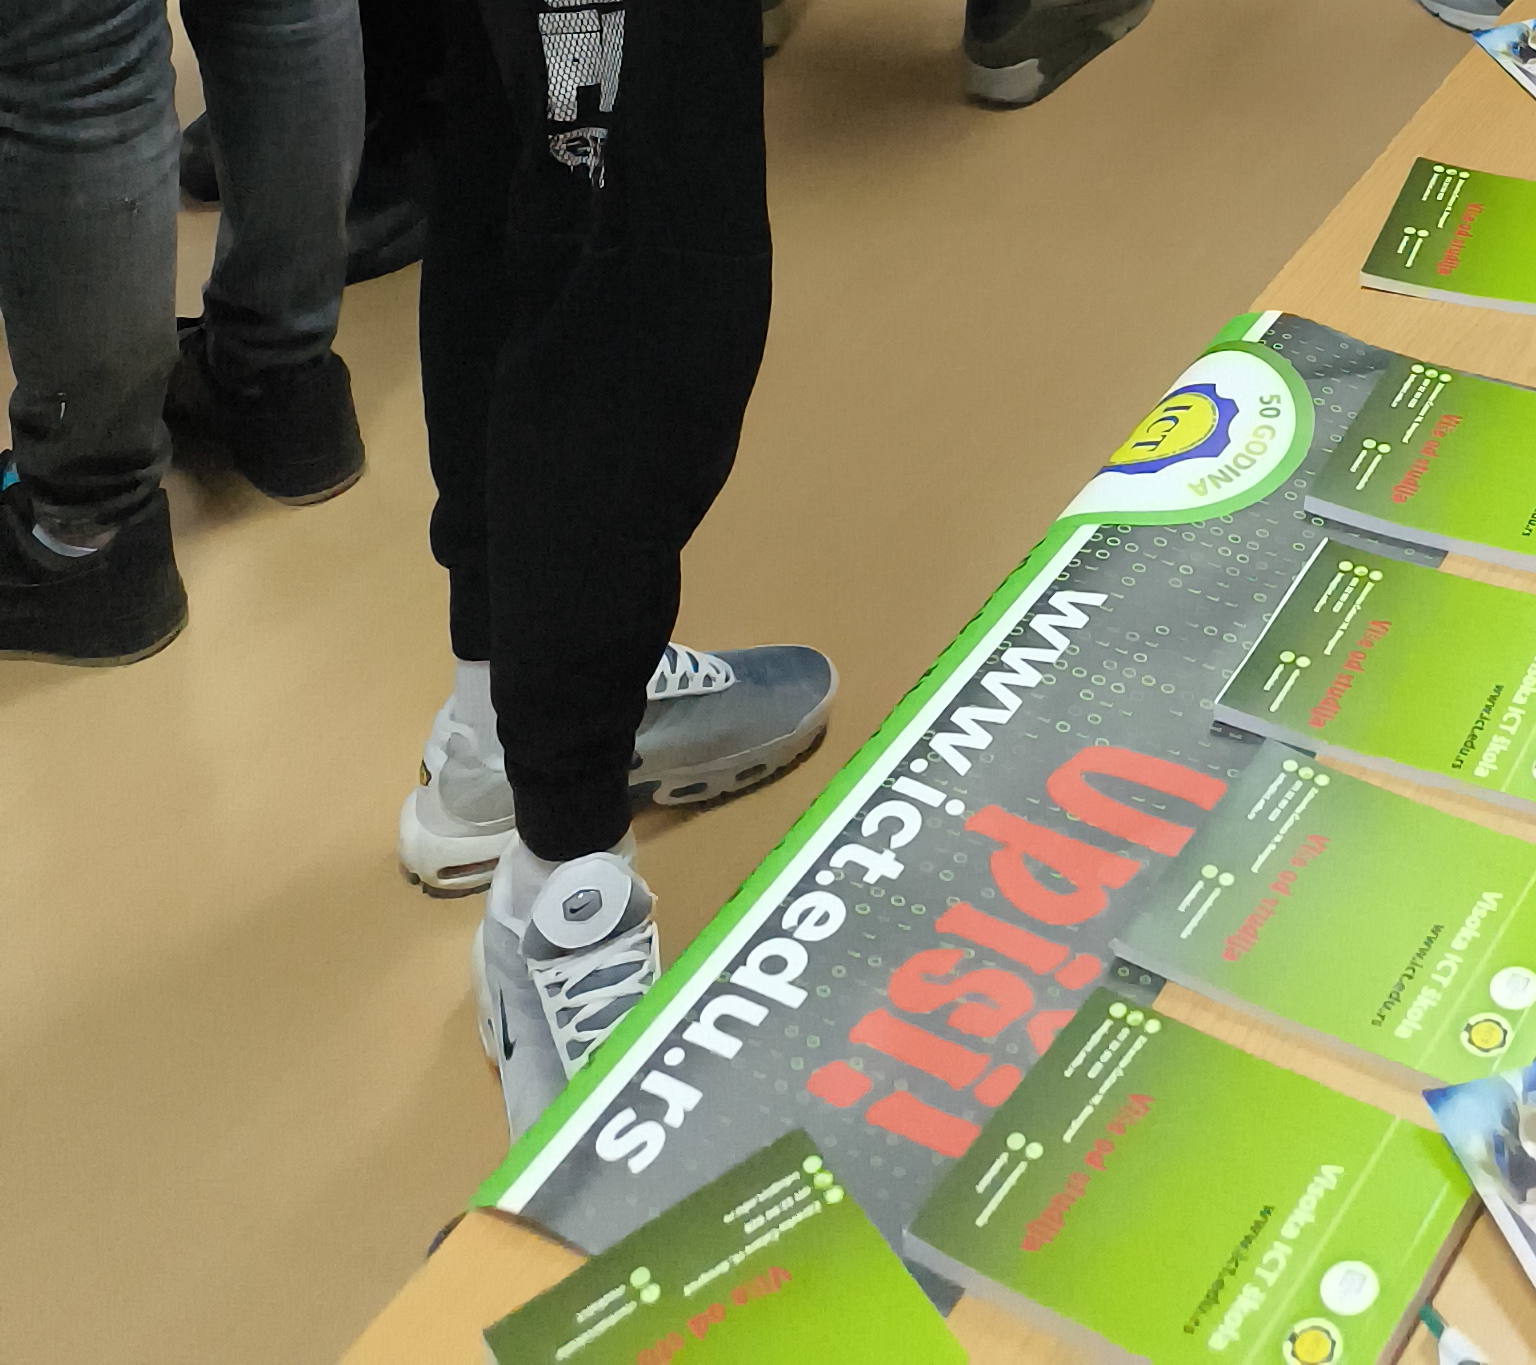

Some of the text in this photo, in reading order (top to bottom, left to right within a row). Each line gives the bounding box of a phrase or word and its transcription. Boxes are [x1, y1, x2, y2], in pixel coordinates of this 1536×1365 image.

[1131, 403, 1194, 453] ICT
[1187, 393, 1282, 498] 50 GODINA
[1421, 440, 1441, 459] od
[1391, 458, 1431, 504] studija
[1344, 651, 1366, 673] od
[1308, 672, 1355, 729] studija
[1500, 702, 1526, 735] ICT
[1452, 685, 1504, 769] www.ict.edu.rs
[1474, 733, 1512, 778] škola
[596, 588, 1108, 1174] www.ict.edu.rs
[1271, 870, 1298, 897] od
[1394, 891, 1504, 1040] Visoka ICT škola
[1281, 1164, 1344, 1239] Visoka
[1255, 1240, 1293, 1288] ICT
